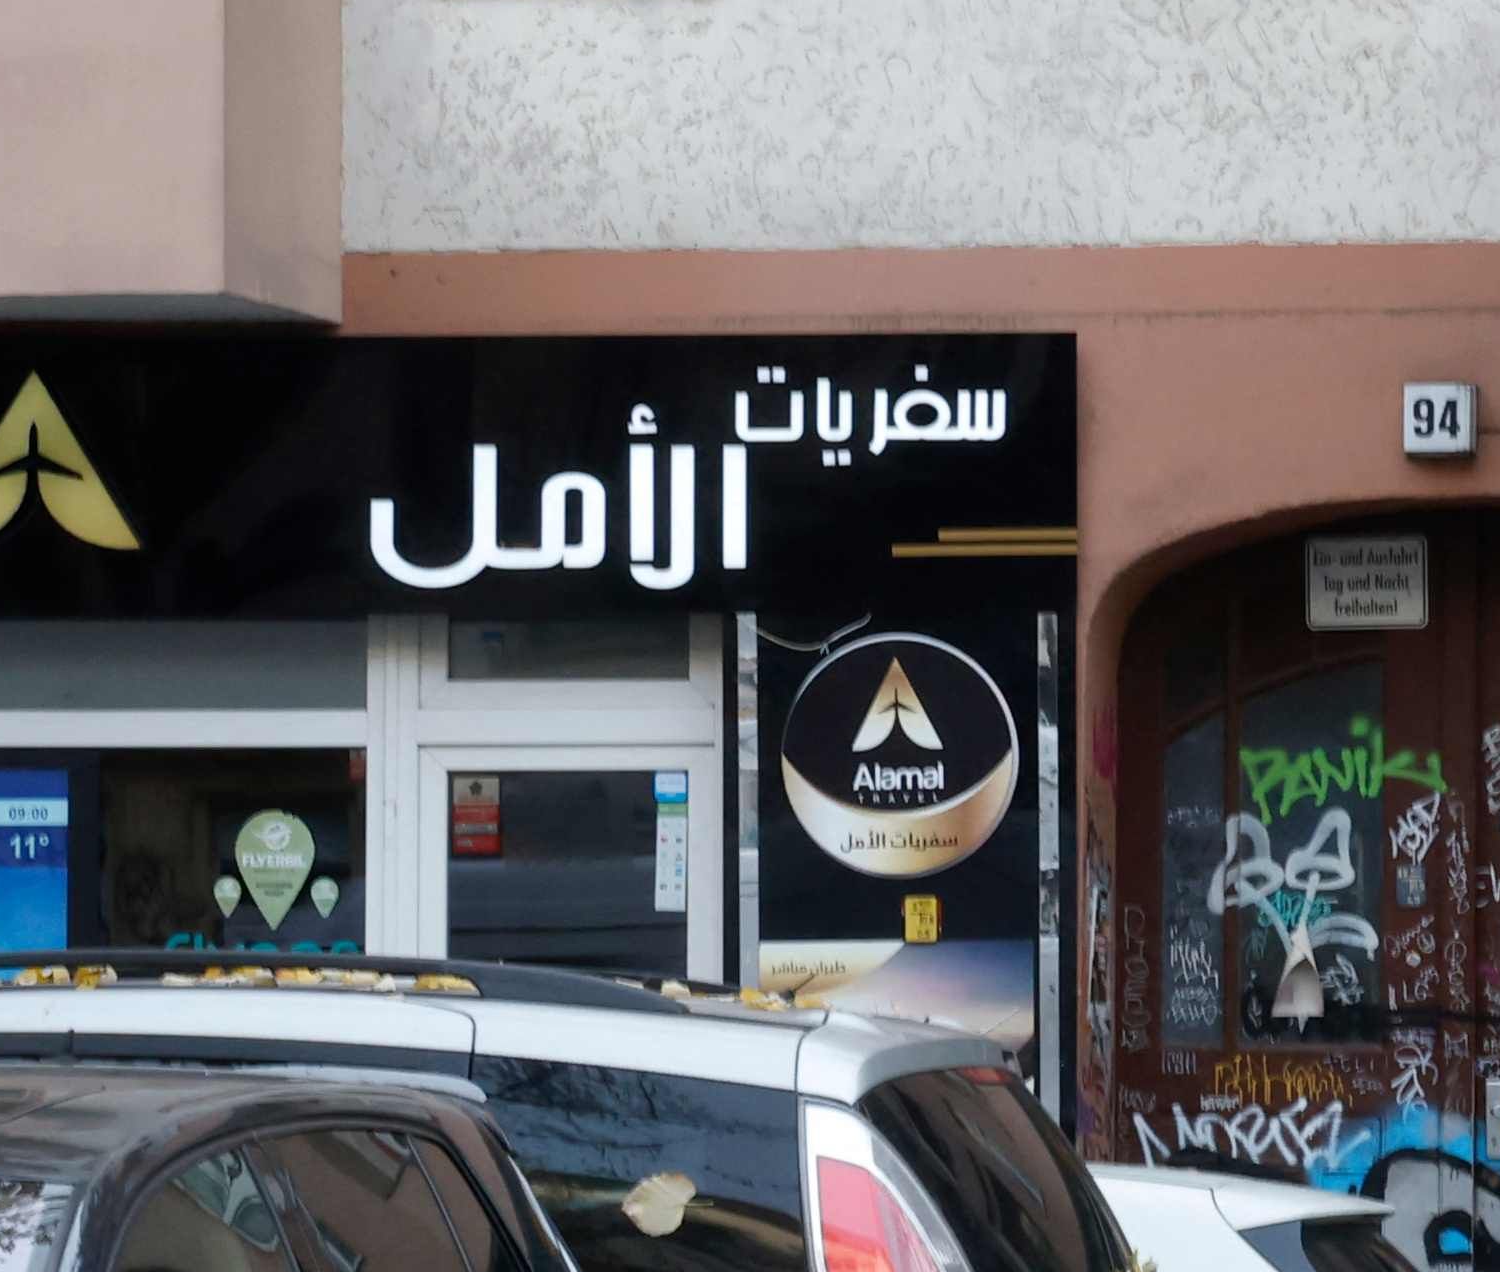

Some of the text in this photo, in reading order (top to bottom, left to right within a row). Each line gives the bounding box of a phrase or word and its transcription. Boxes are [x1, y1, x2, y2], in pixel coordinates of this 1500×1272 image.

[734, 364, 1007, 468] سفريات
[1413, 398, 1461, 439] 94
[368, 404, 747, 591] الأمل
[1340, 546, 1363, 566] und
[1367, 546, 1419, 566] Ausfahrt
[1324, 573, 1408, 596] Tag und Nacht
[853, 760, 945, 792] Alamal
[857, 792, 941, 805] TRAVEL
[840, 829, 960, 854] سفريات الأمل
